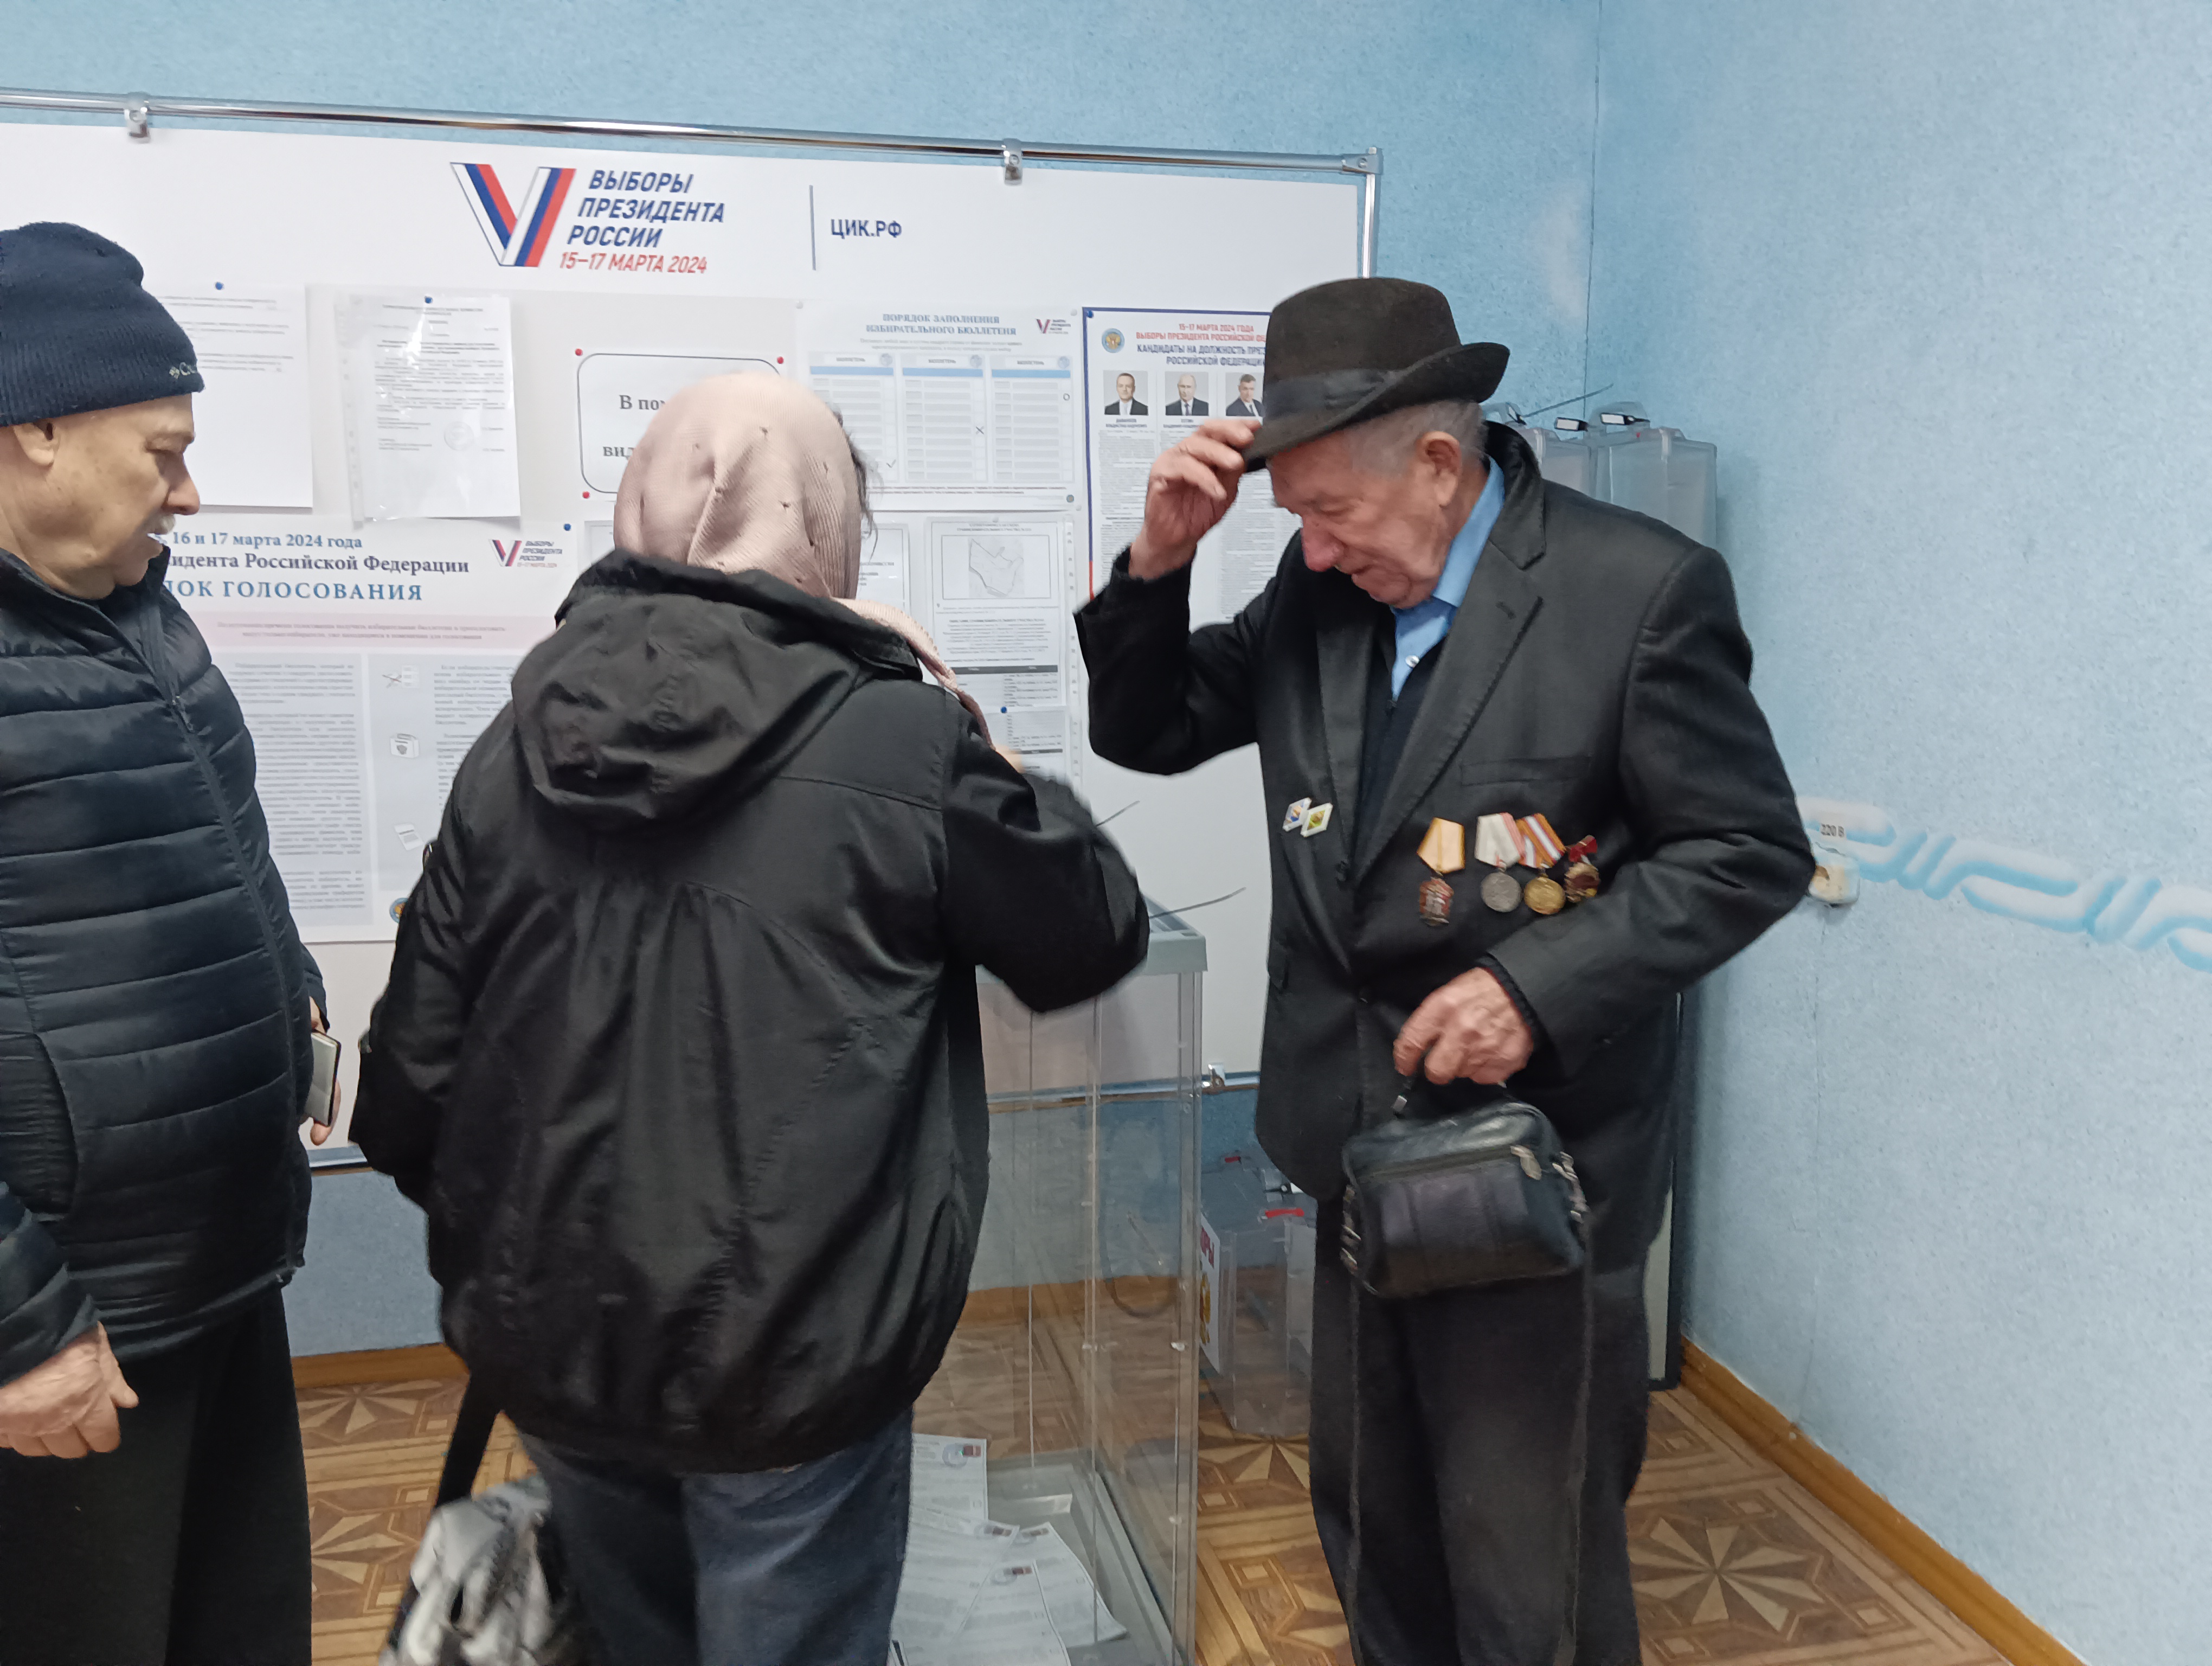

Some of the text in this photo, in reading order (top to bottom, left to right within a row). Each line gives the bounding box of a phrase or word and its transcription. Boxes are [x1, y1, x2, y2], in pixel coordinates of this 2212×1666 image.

[588, 170, 694, 193] ВЫБОРЫ
[577, 197, 725, 223] ПРЕЗИДЕНТА
[567, 225, 663, 248] РОССИИ
[831, 219, 902, 239] ЦИК.РФ
[608, 253, 665, 272] МАРТА
[667, 255, 708, 273] 2024
[883, 313, 930, 323] ПОРЯДОК
[619, 394, 666, 411] В по
[173, 531, 190, 544] 16
[195, 535, 205, 544] и
[211, 532, 228, 545] 17
[233, 535, 281, 549] марта
[286, 534, 323, 547] 2024
[327, 537, 363, 549] года
[245, 553, 358, 570] Российской
[363, 555, 470, 575] Федерации
[223, 581, 422, 600] ГОЛОСОВАНИЯ
